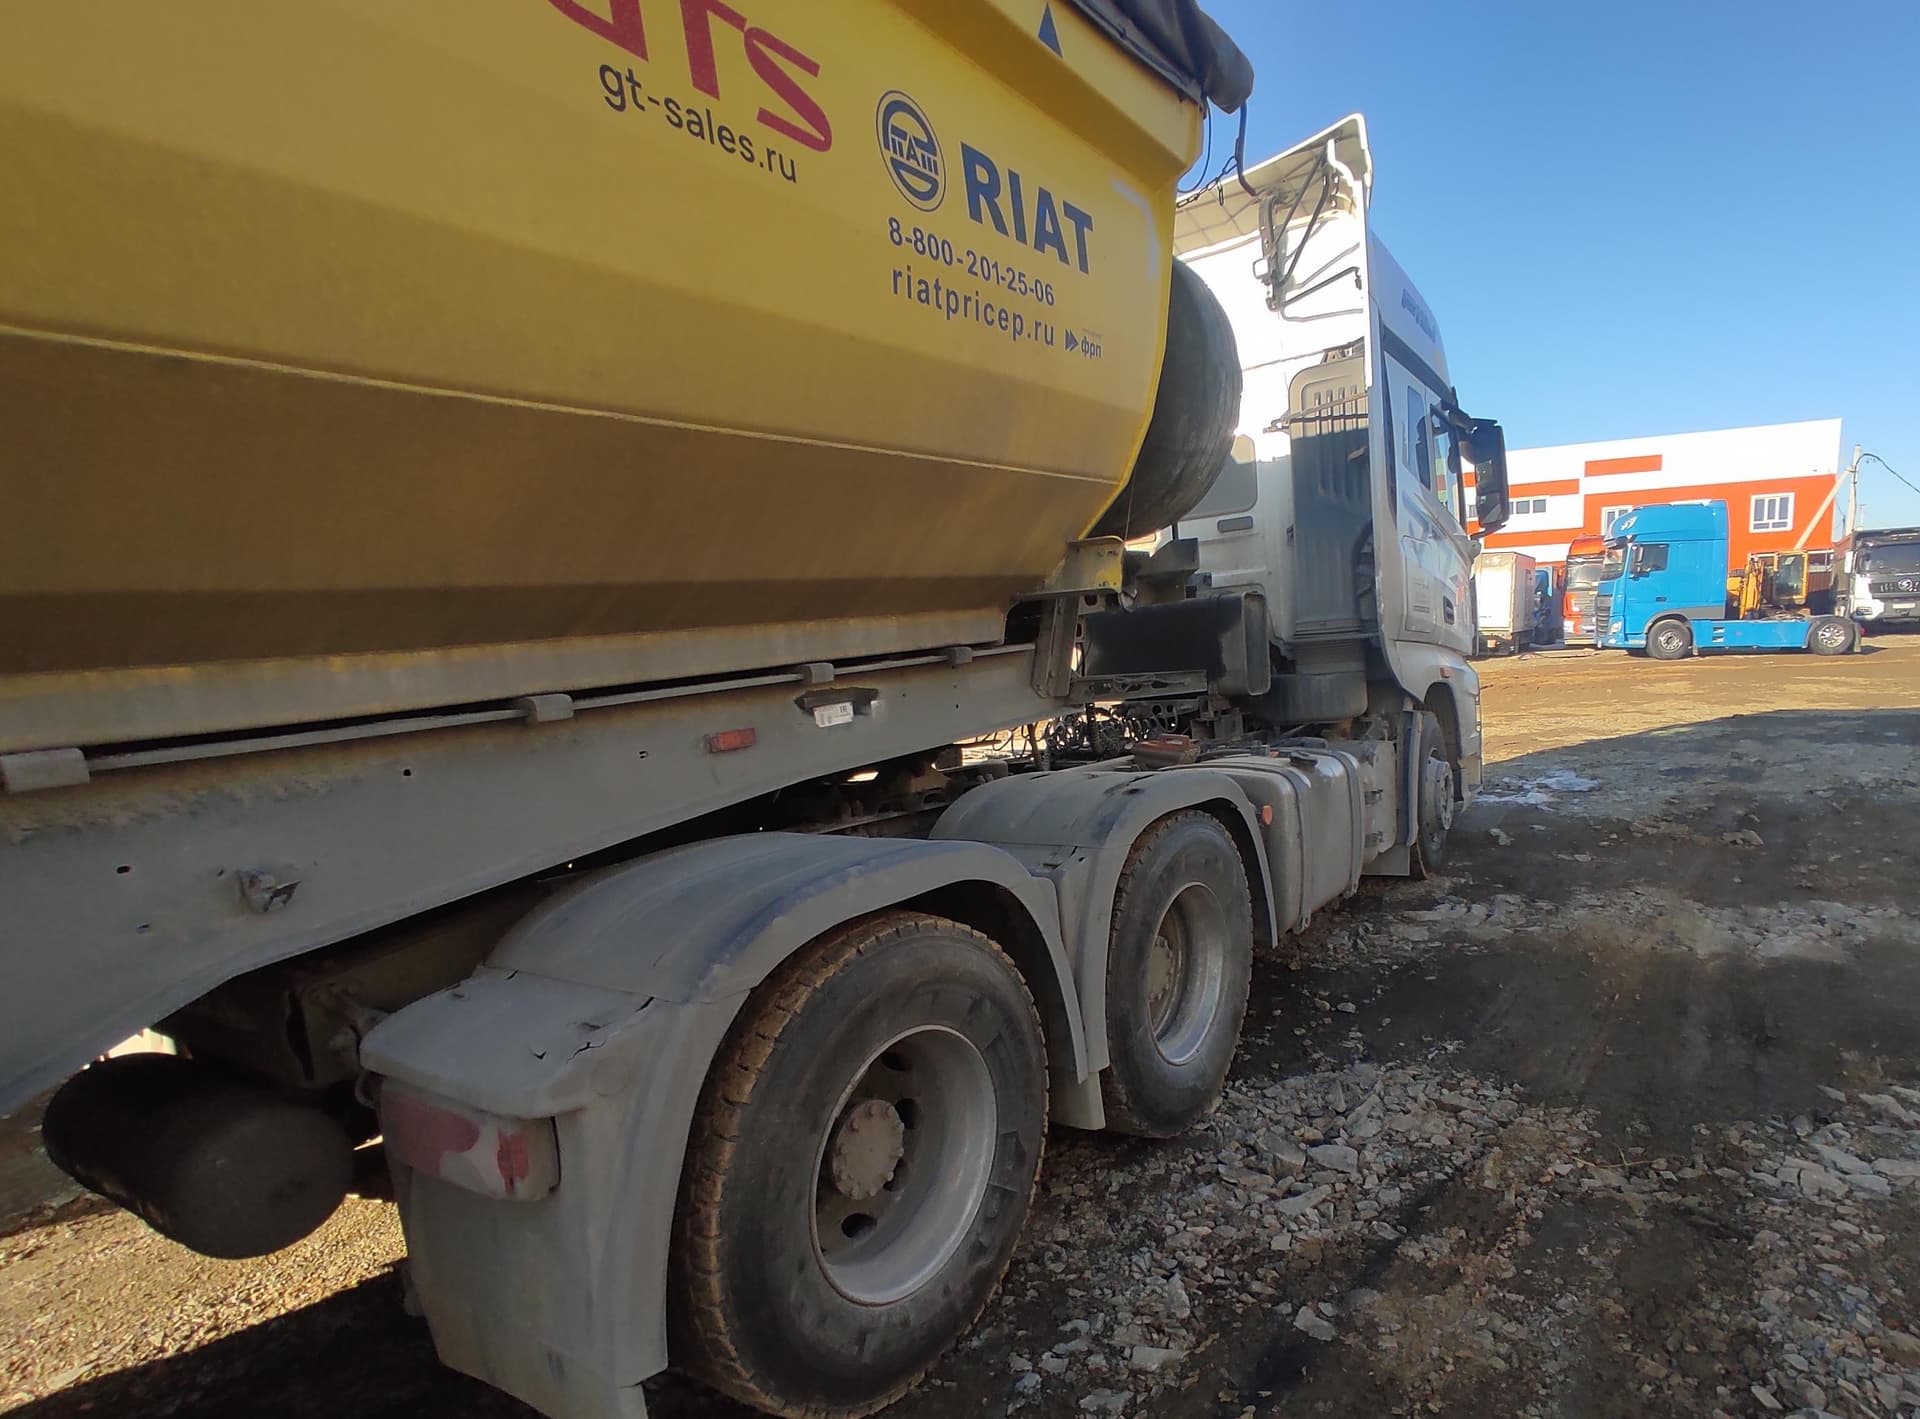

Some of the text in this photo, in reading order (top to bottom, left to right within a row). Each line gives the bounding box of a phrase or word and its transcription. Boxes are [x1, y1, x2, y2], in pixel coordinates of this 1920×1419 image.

[599, 64, 797, 183] gt-sales.ru
[960, 141, 1094, 275] RIAT
[888, 217, 1055, 306] 8-800-201-25-06
[892, 265, 1055, 346] riatpricep.ru
